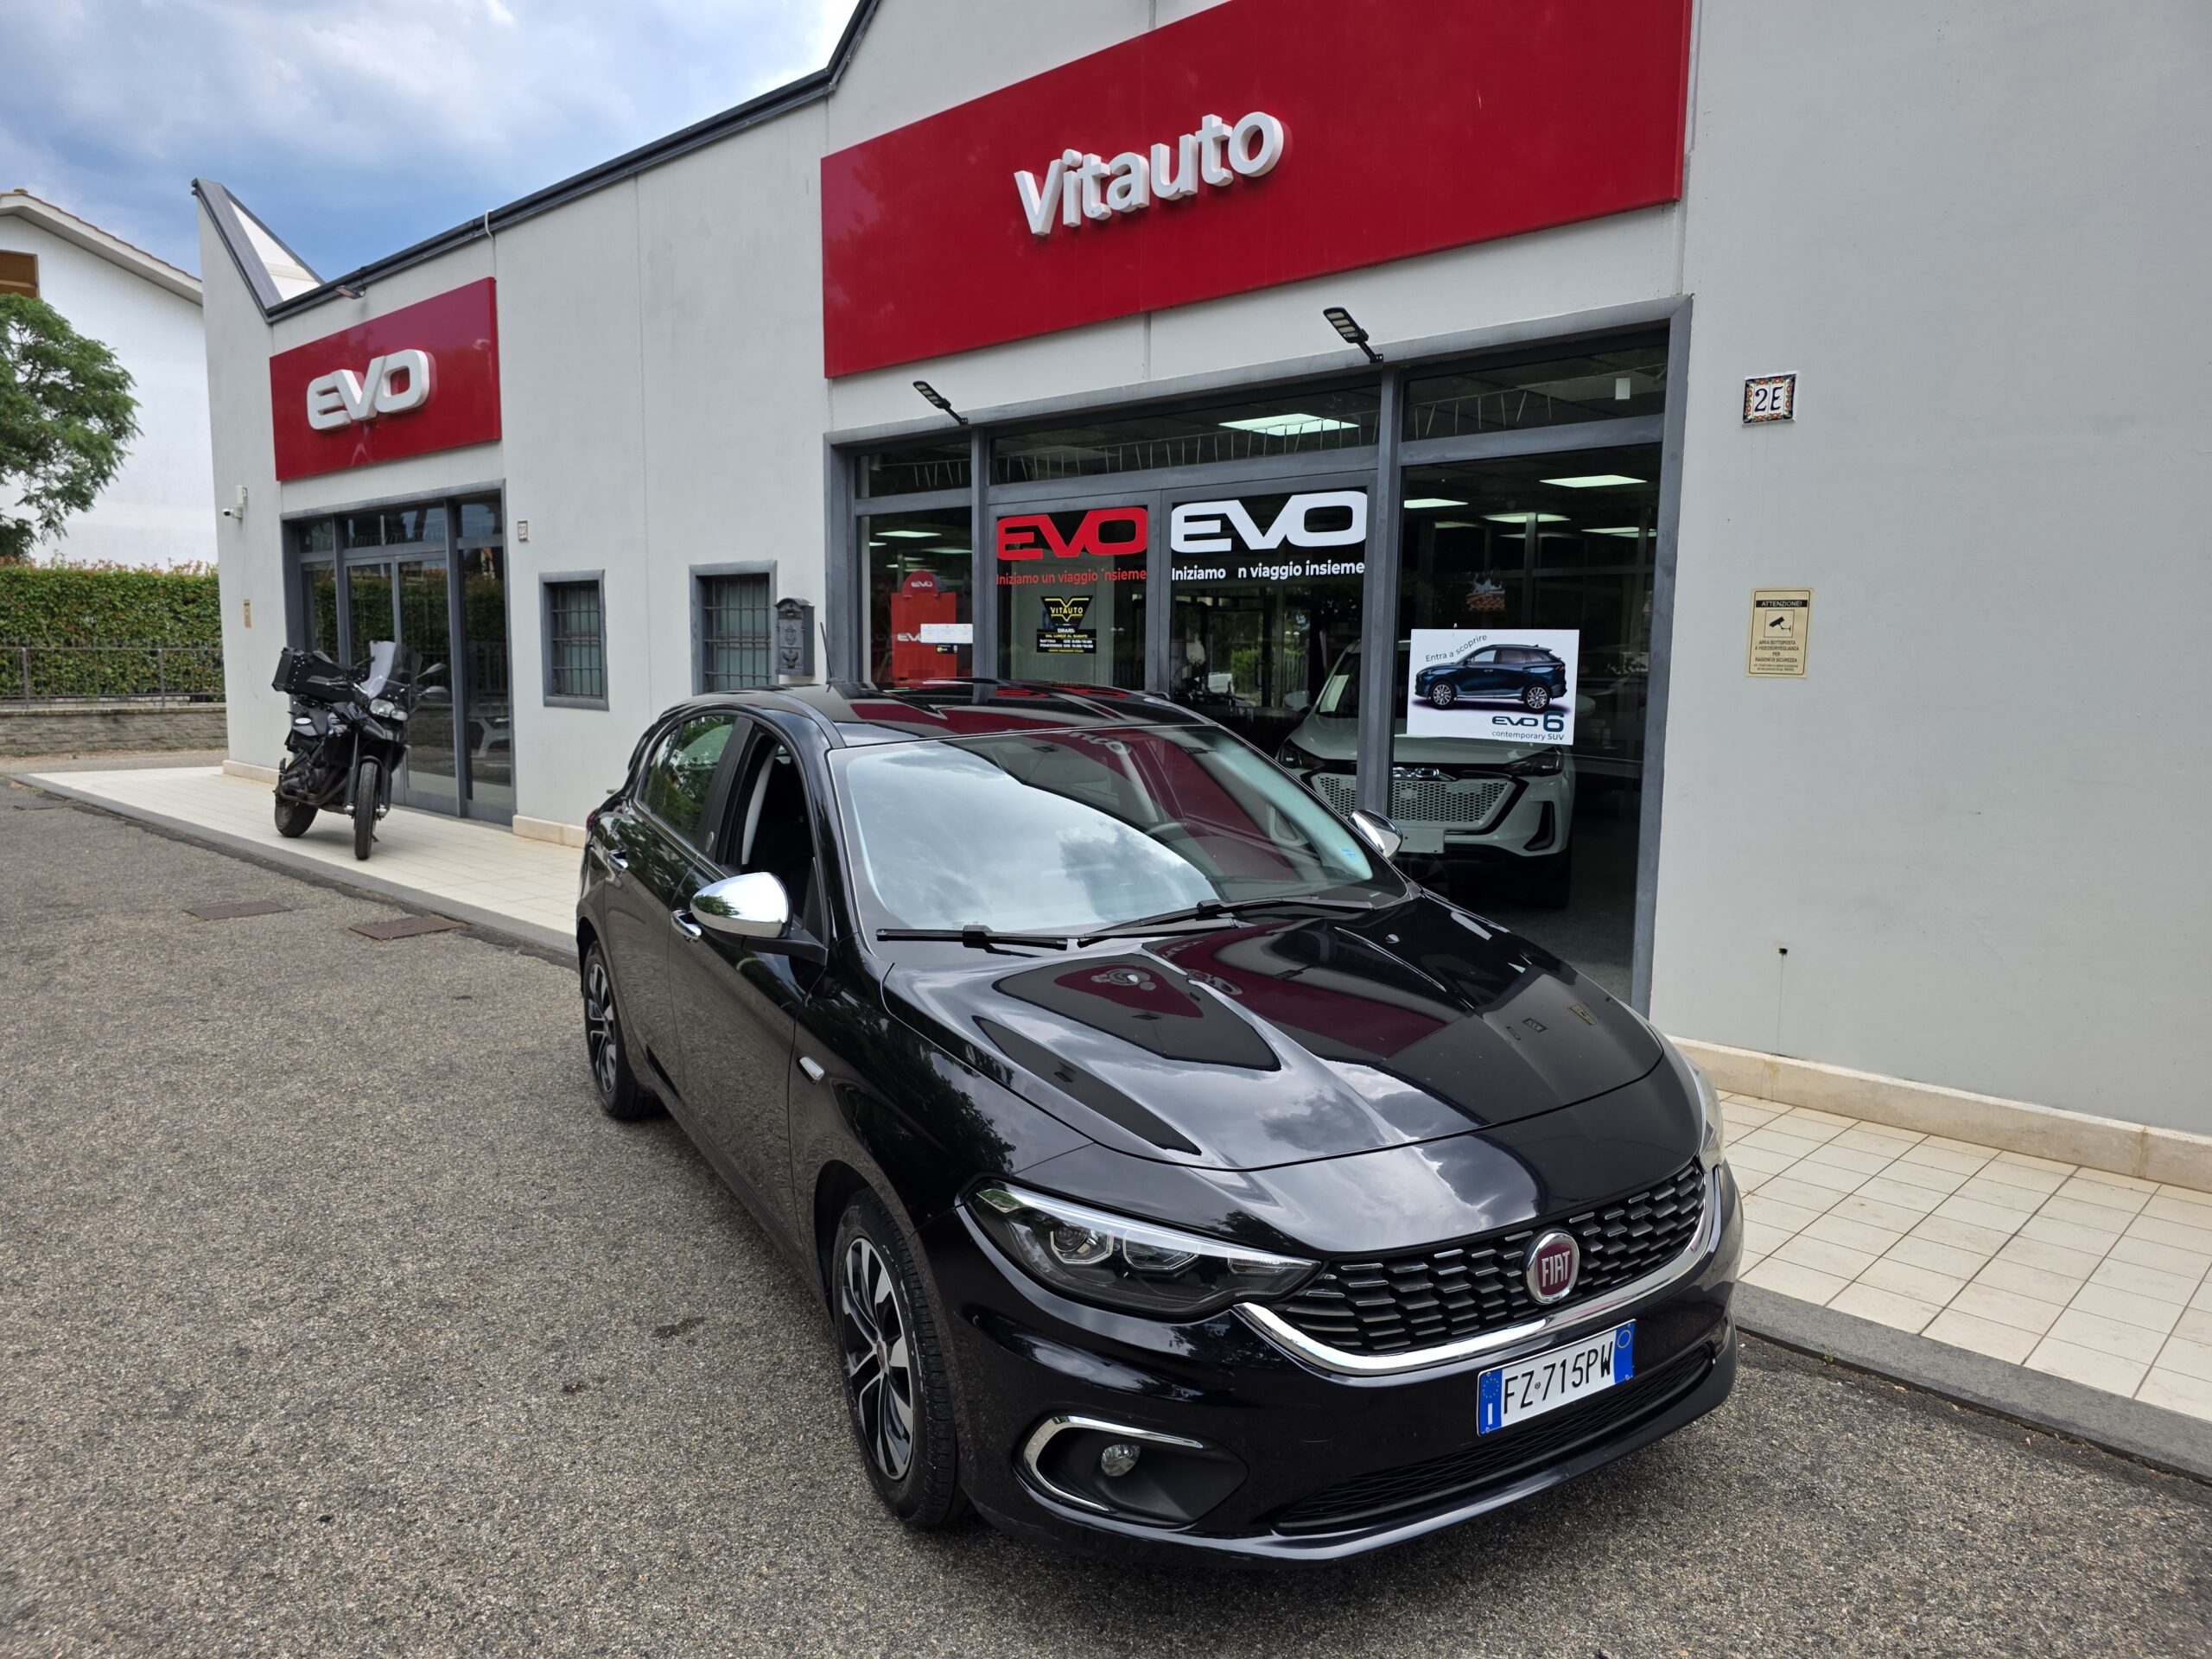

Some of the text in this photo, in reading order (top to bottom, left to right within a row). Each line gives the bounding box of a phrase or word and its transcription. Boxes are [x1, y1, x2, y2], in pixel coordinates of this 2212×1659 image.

[1014, 111, 1284, 236] Vitauto
[307, 348, 430, 430] EVO
[1754, 385, 1783, 412] 2E
[997, 506, 1147, 561] EVO
[1171, 491, 1368, 554] EVO
[995, 568, 1147, 585] Iniziamo un viaggio nsieme
[1172, 565, 1226, 581] Iniziamo
[1249, 562, 1302, 580] viaggio
[1306, 559, 1365, 575] insieme
[897, 632, 922, 641] EV
[1425, 652, 1447, 662] Entra
[1455, 634, 1487, 655] scoprire
[1491, 710, 1565, 733] EVO 6
[1491, 731, 1546, 741] contemporary
[1541, 1250, 1570, 1287] FIAT
[1542, 1340, 1613, 1402] 715PW
